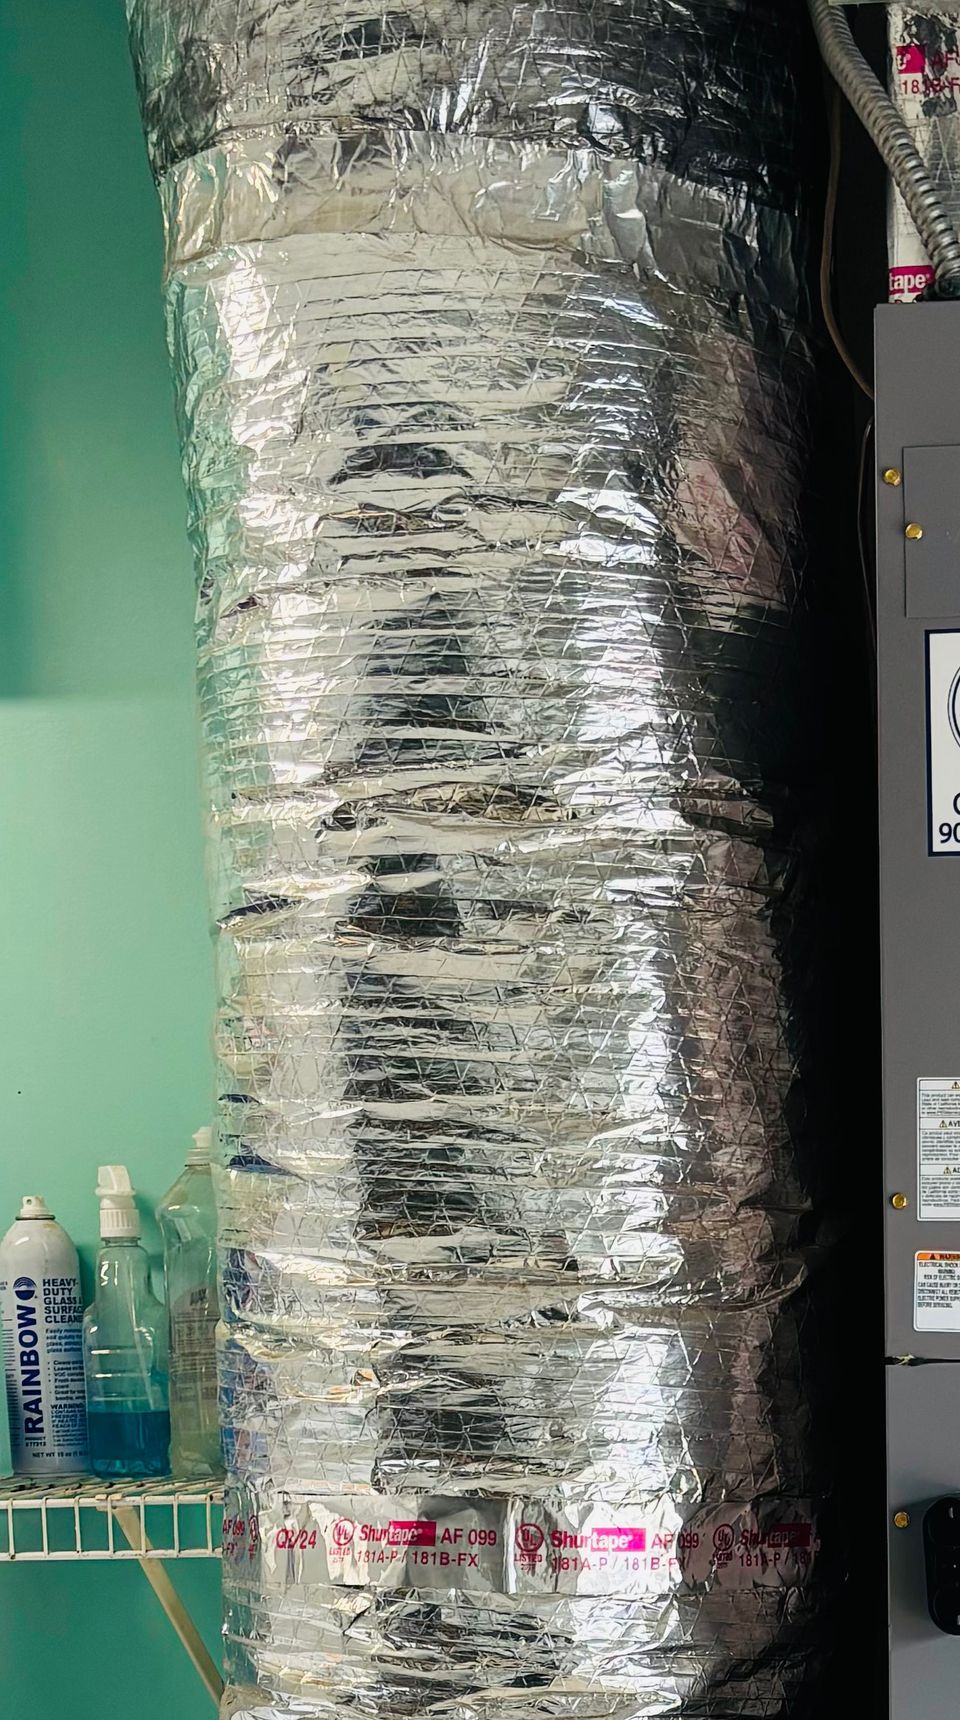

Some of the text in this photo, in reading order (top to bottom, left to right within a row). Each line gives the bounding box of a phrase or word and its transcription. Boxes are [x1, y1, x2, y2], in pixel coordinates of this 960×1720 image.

[43, 1288, 72, 1296] DUTY
[44, 1297, 77, 1305] GLASS
[16, 1304, 44, 1434] RAINBOW
[359, 1524, 496, 1547] Shurtape AF 099
[551, 1529, 699, 1551] Shurtape AF 099
[357, 1551, 477, 1567] 181A-P 181B-FX
[552, 1556, 688, 1571] 181A-P 181B-FX
